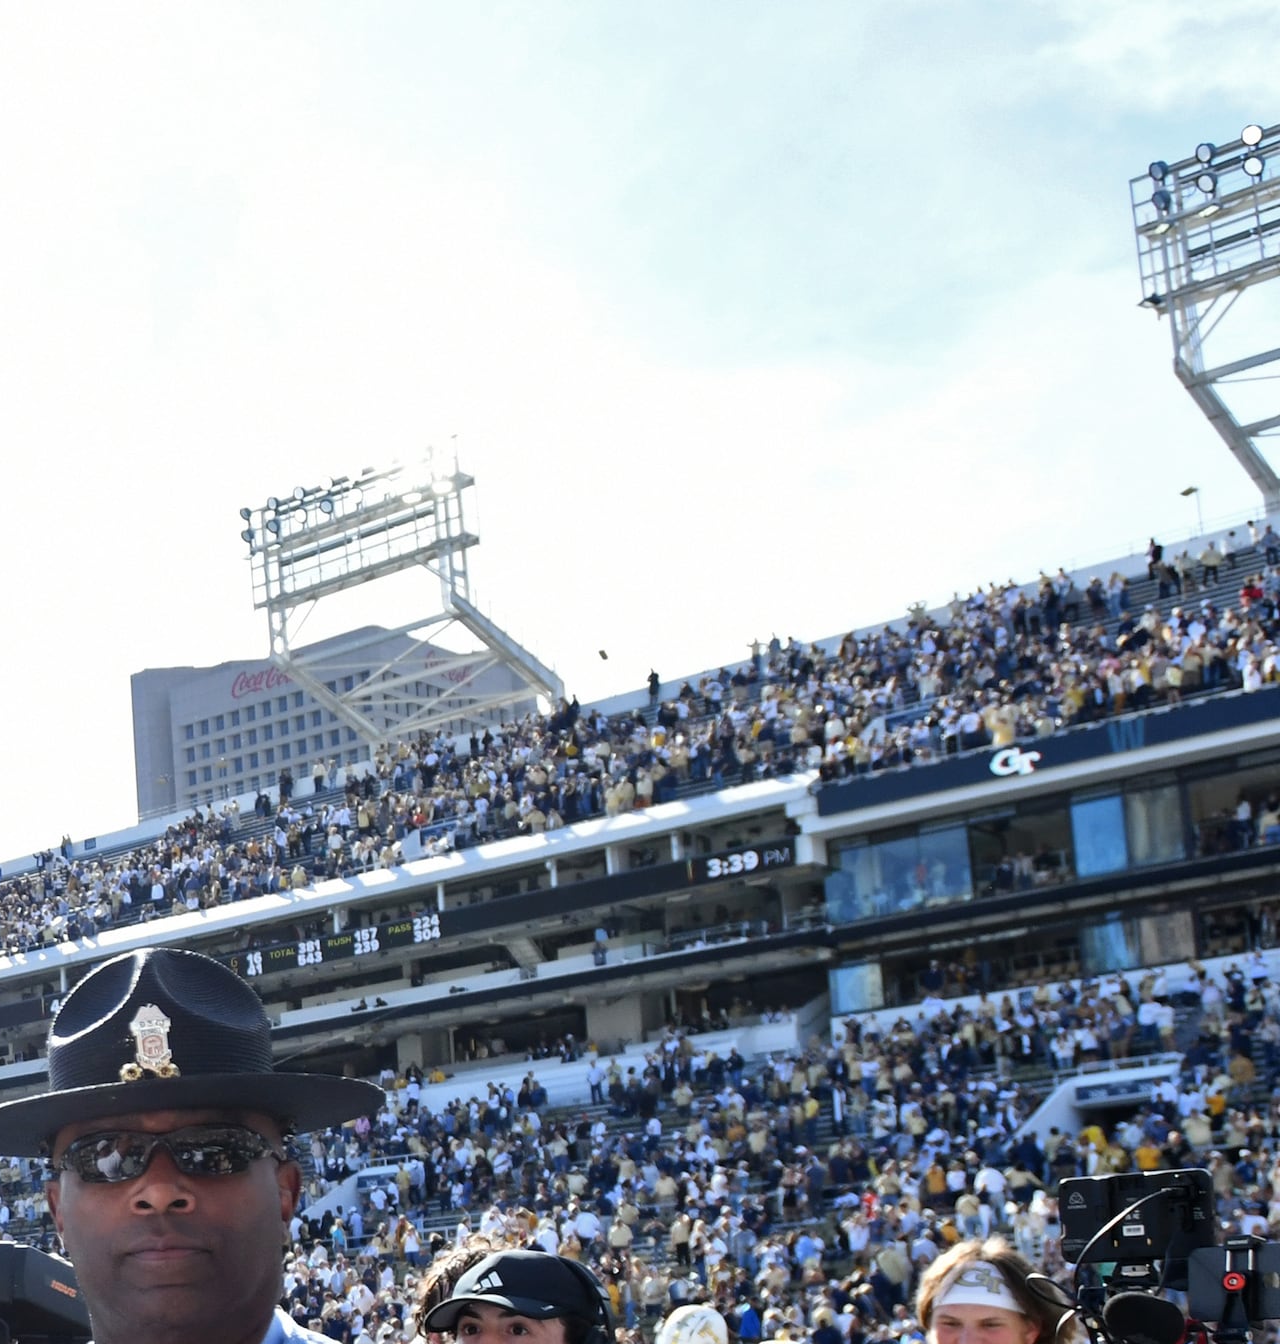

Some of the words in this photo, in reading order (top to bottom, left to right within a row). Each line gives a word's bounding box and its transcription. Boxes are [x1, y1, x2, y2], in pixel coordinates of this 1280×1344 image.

[706, 850, 759, 878] 3:39
[763, 847, 791, 867] PM
[269, 948, 296, 960] TOTAL
[327, 936, 352, 948] RUSH
[353, 927, 378, 942] 157
[387, 923, 412, 936] PASS
[413, 914, 440, 930] 224
[413, 927, 440, 943] 304
[353, 940, 380, 955] 239
[246, 951, 262, 965] 16
